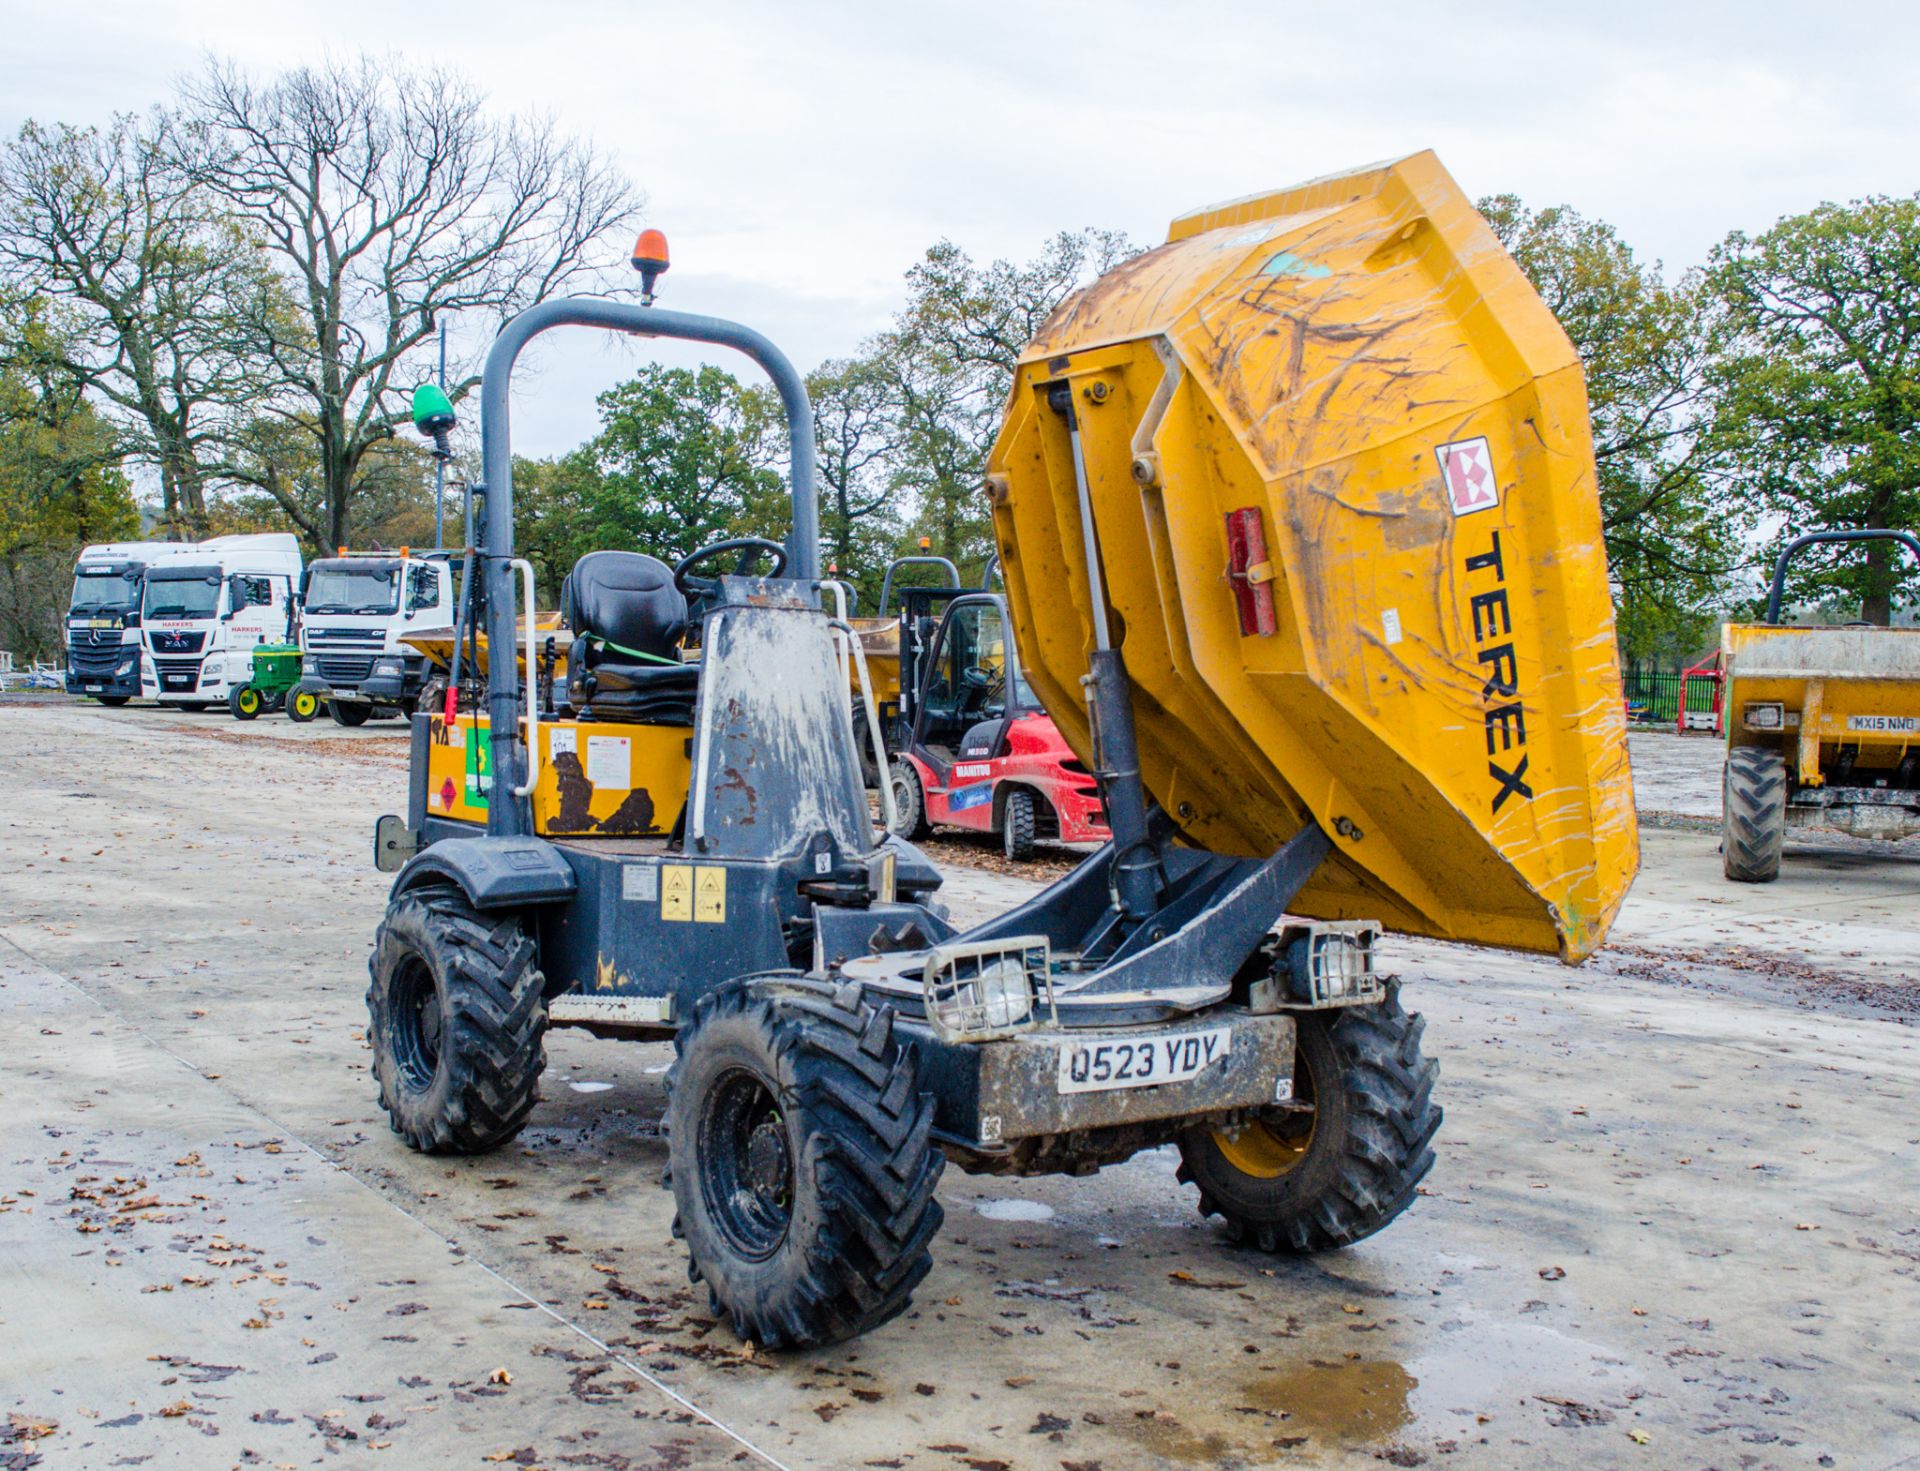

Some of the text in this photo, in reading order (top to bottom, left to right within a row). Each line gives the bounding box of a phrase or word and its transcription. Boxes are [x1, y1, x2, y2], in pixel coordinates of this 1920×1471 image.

[164, 640, 190, 648] MAN
[1465, 530, 1534, 815] TEREX
[1855, 717, 1885, 729] MX15
[956, 764, 990, 777] MANITOU
[1071, 1034, 1218, 1082] Q523 YDY
